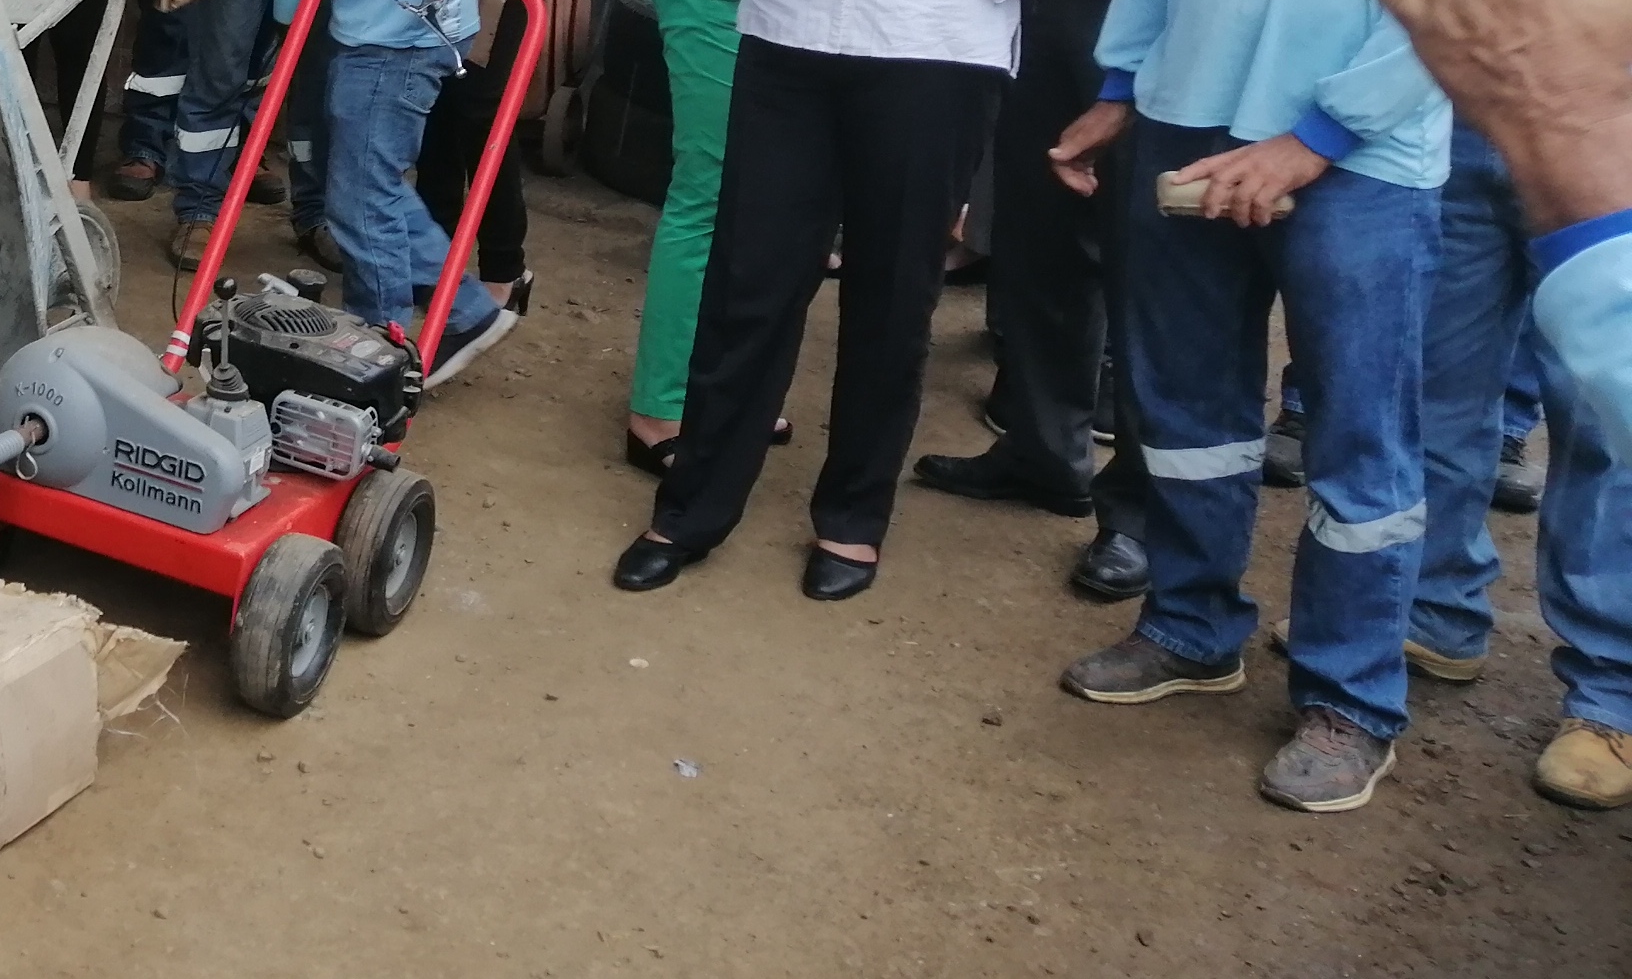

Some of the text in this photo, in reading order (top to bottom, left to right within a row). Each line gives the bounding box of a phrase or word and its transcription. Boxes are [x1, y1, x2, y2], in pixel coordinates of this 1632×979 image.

[14, 381, 65, 407] K-1000
[113, 438, 206, 484] RIDGID
[110, 469, 203, 515] Kollmann
